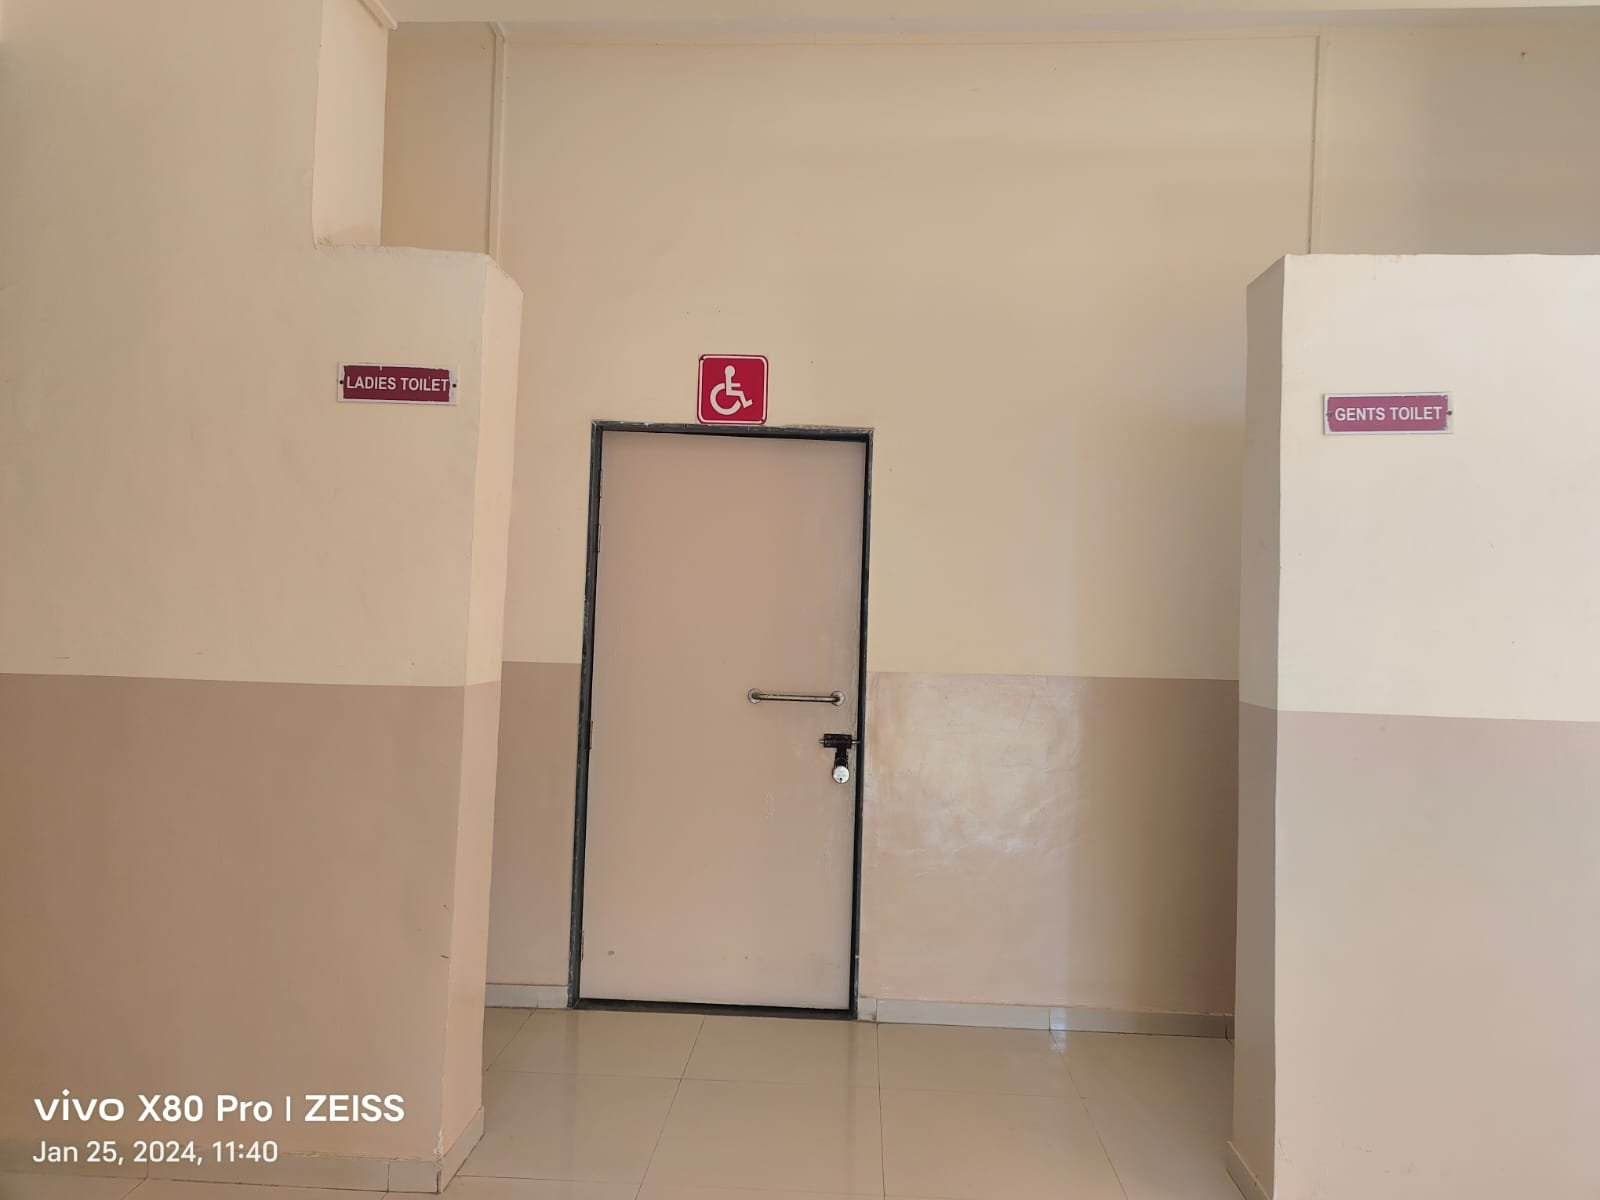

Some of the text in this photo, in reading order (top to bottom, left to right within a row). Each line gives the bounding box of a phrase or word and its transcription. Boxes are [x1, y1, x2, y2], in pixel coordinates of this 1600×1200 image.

[346, 376, 449, 392] LADIES TOILET
[1335, 406, 1443, 421] GENTS TOILET
